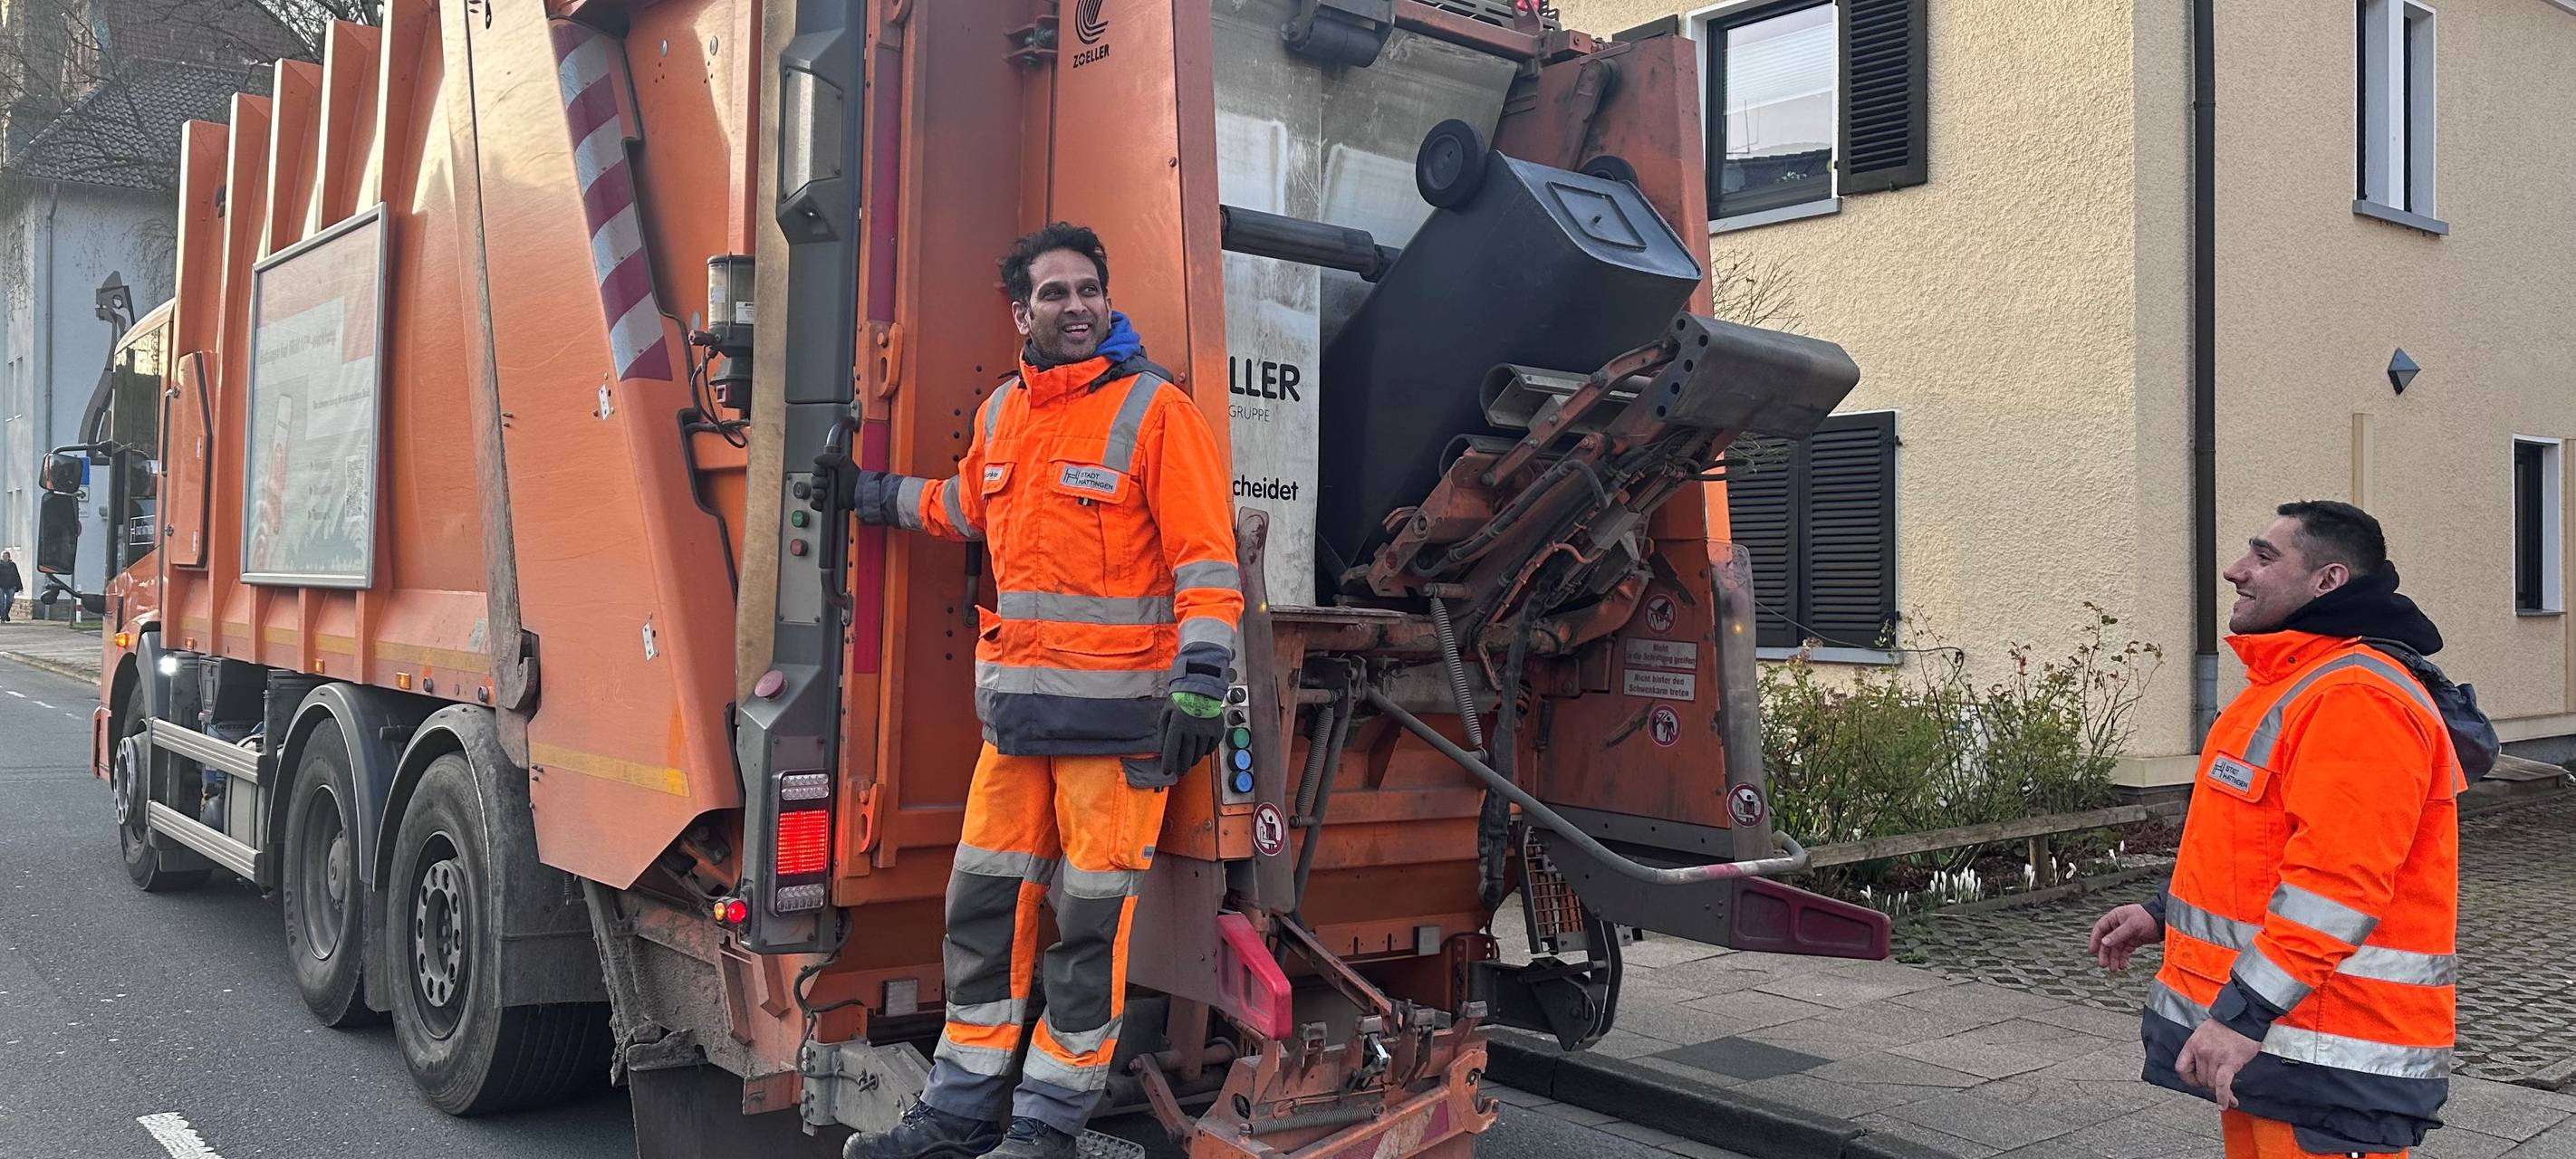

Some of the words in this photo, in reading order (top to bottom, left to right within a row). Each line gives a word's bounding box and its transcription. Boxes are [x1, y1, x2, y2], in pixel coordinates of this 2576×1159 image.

[1073, 43, 1110, 68] ZOELLER
[1229, 356, 1300, 402] LLER
[1228, 405, 1270, 422] GRUPPE
[1078, 478, 1113, 491] HATTINGEN
[1233, 474, 1299, 501] cheidet
[1634, 674, 1650, 683] Nicht
[1652, 674, 1671, 685] hinter
[1672, 676, 1685, 685] den
[1629, 684, 1668, 695] Schwenkarm
[1669, 688, 1689, 696] treten
